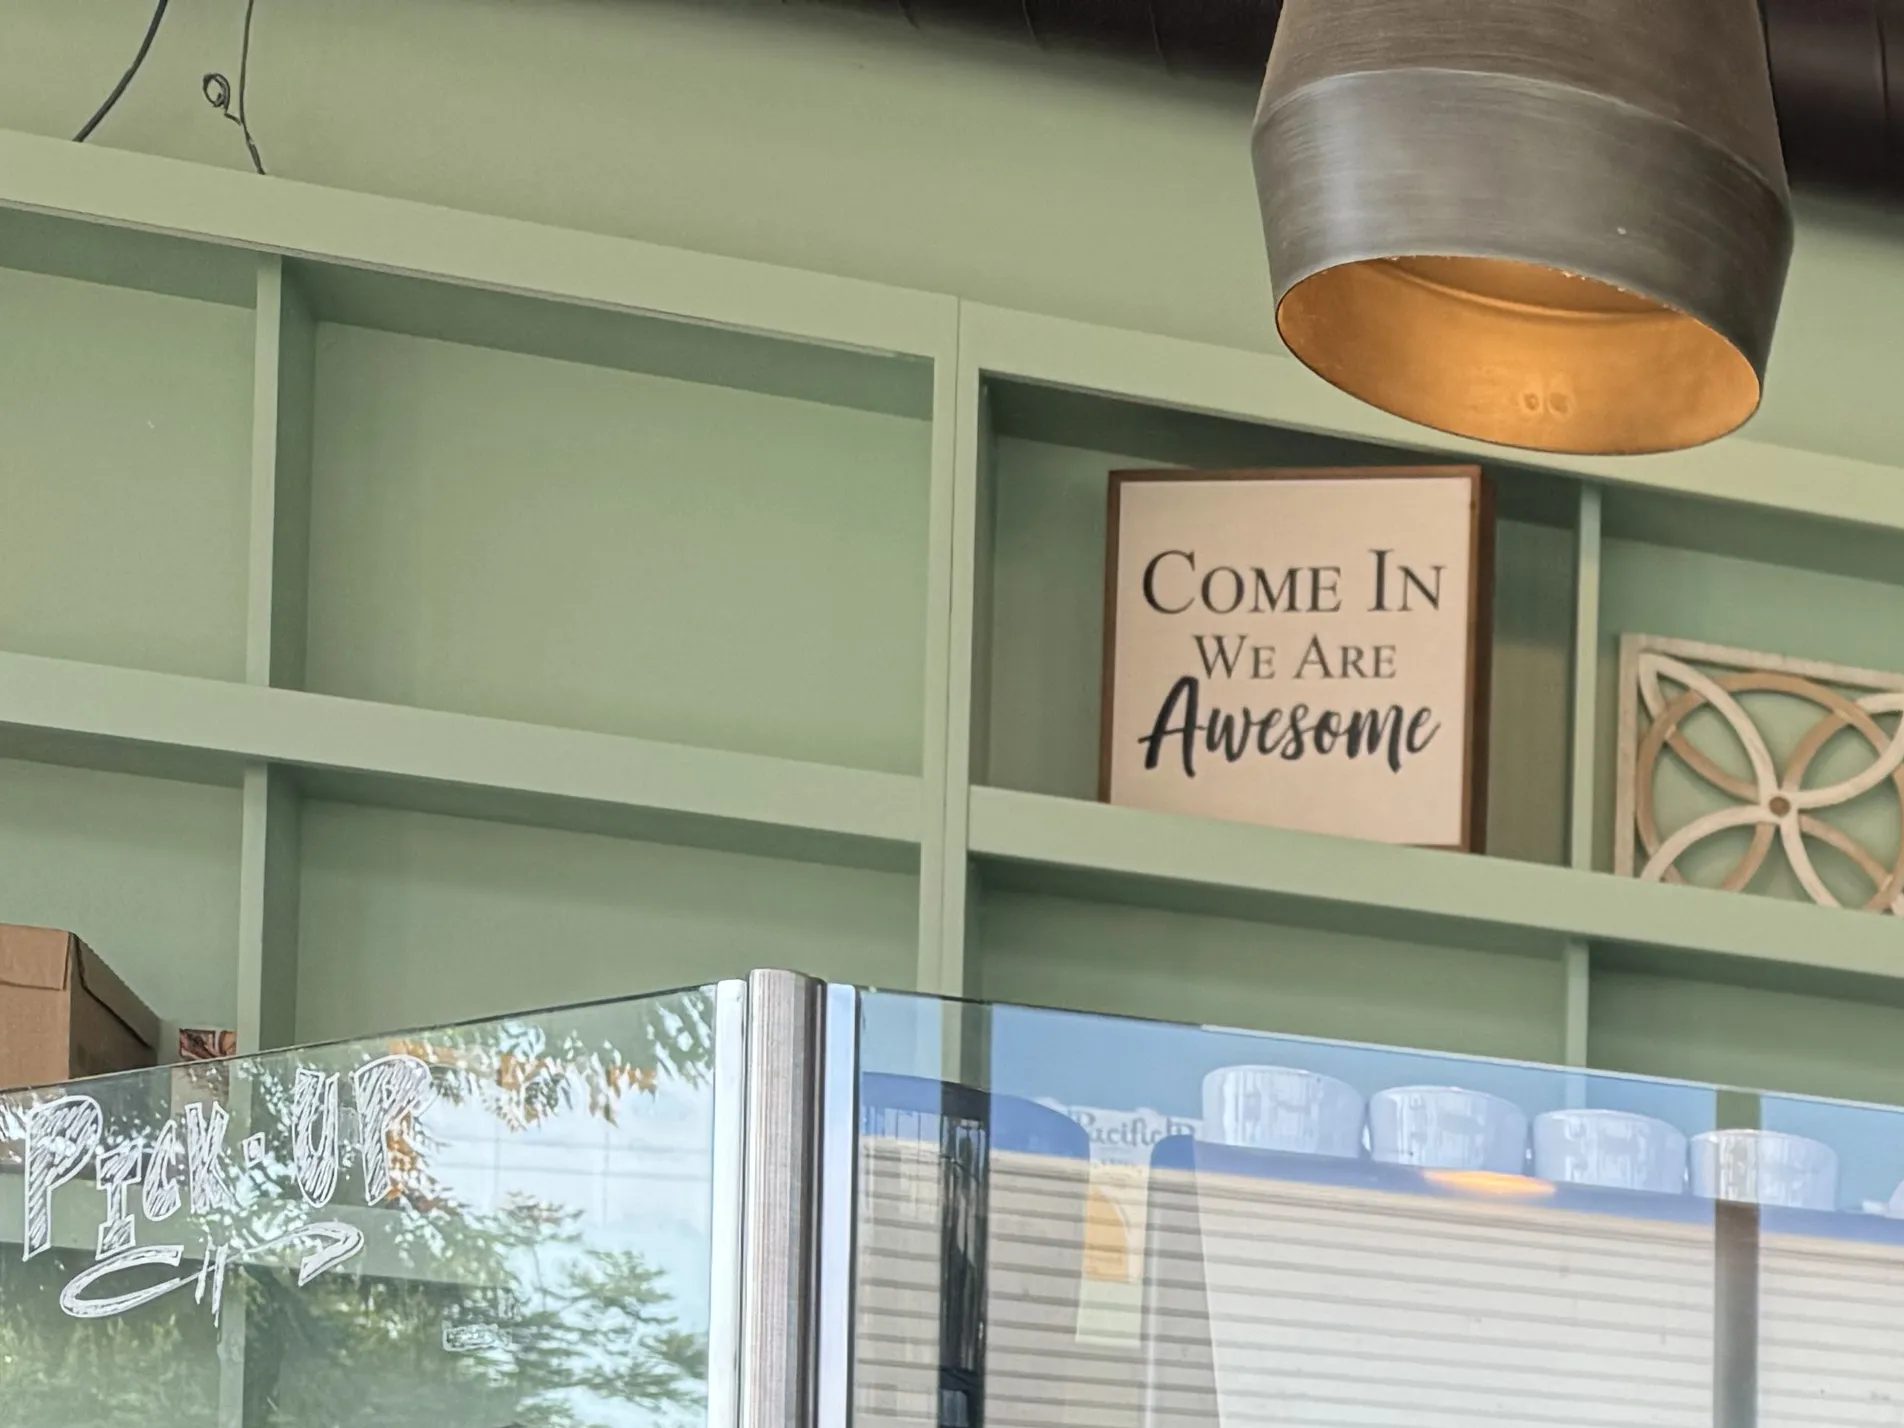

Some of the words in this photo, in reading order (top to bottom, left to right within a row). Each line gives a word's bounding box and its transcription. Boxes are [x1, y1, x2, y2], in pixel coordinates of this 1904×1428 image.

[1142, 549, 1344, 615] COME
[1367, 548, 1447, 613] IN
[1192, 633, 1278, 681] WE
[1292, 633, 1397, 680] ARE
[1137, 675, 1441, 779] Awesome
